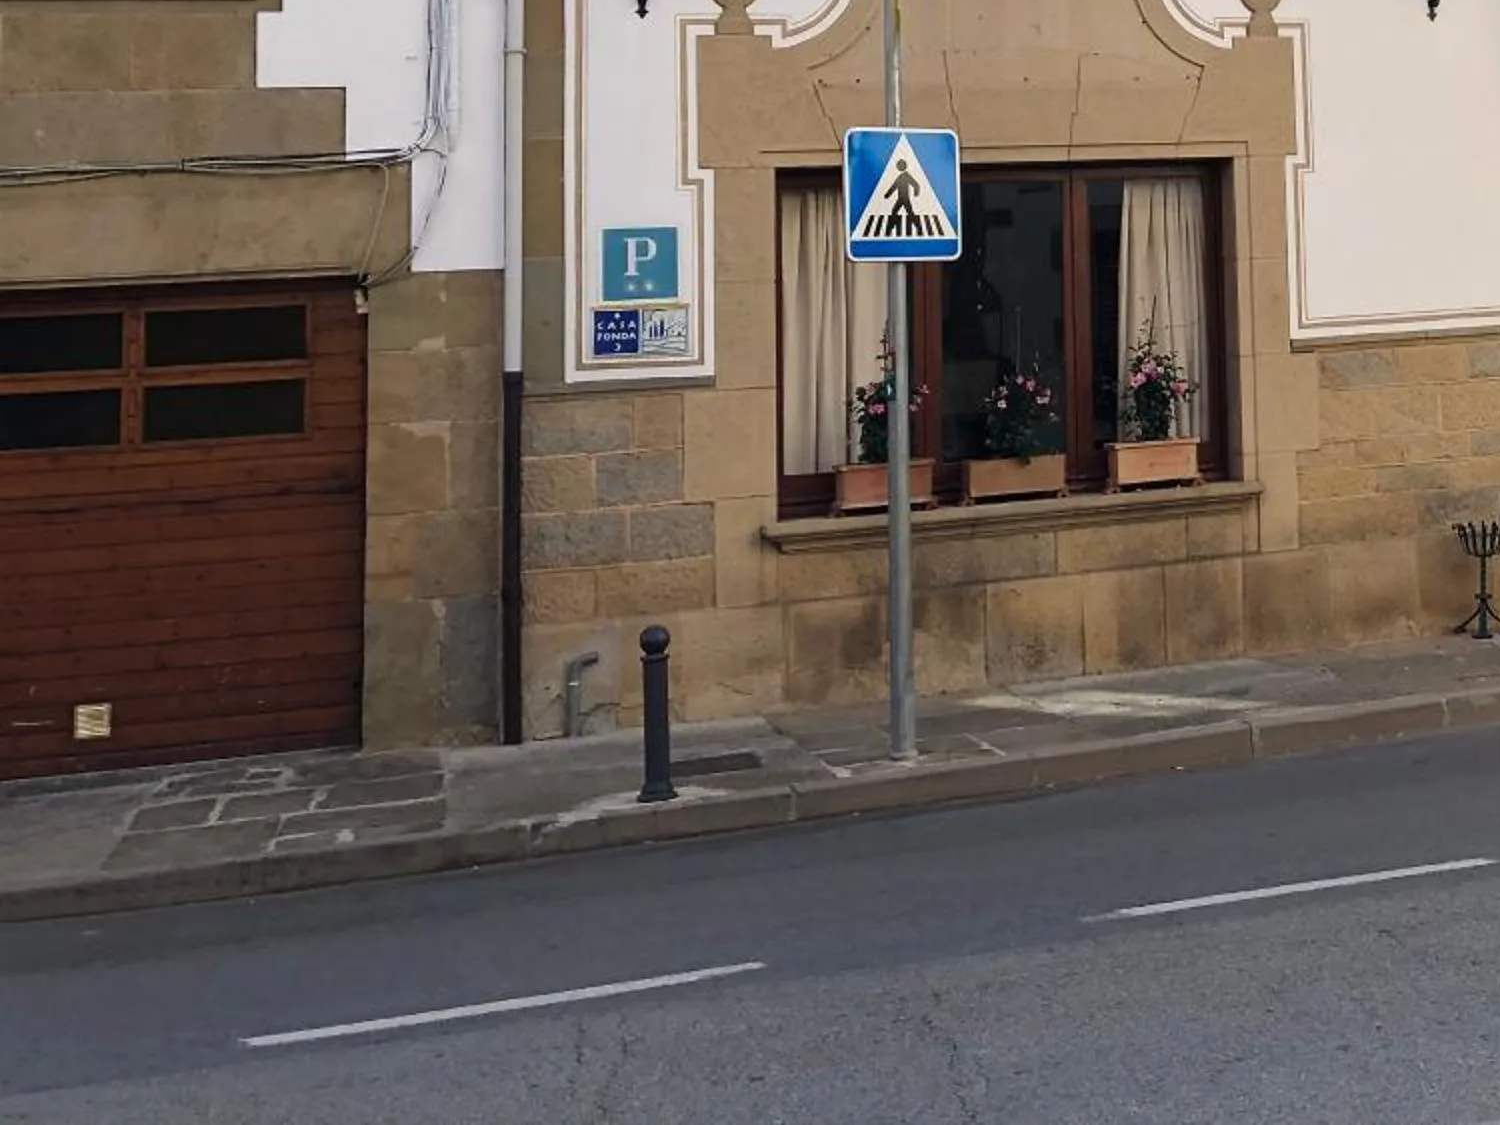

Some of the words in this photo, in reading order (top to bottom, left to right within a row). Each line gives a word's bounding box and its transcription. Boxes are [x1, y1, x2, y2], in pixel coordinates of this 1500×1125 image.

[623, 236, 657, 276] P
[597, 320, 637, 330] CASA
[597, 332, 637, 341] FONDA
